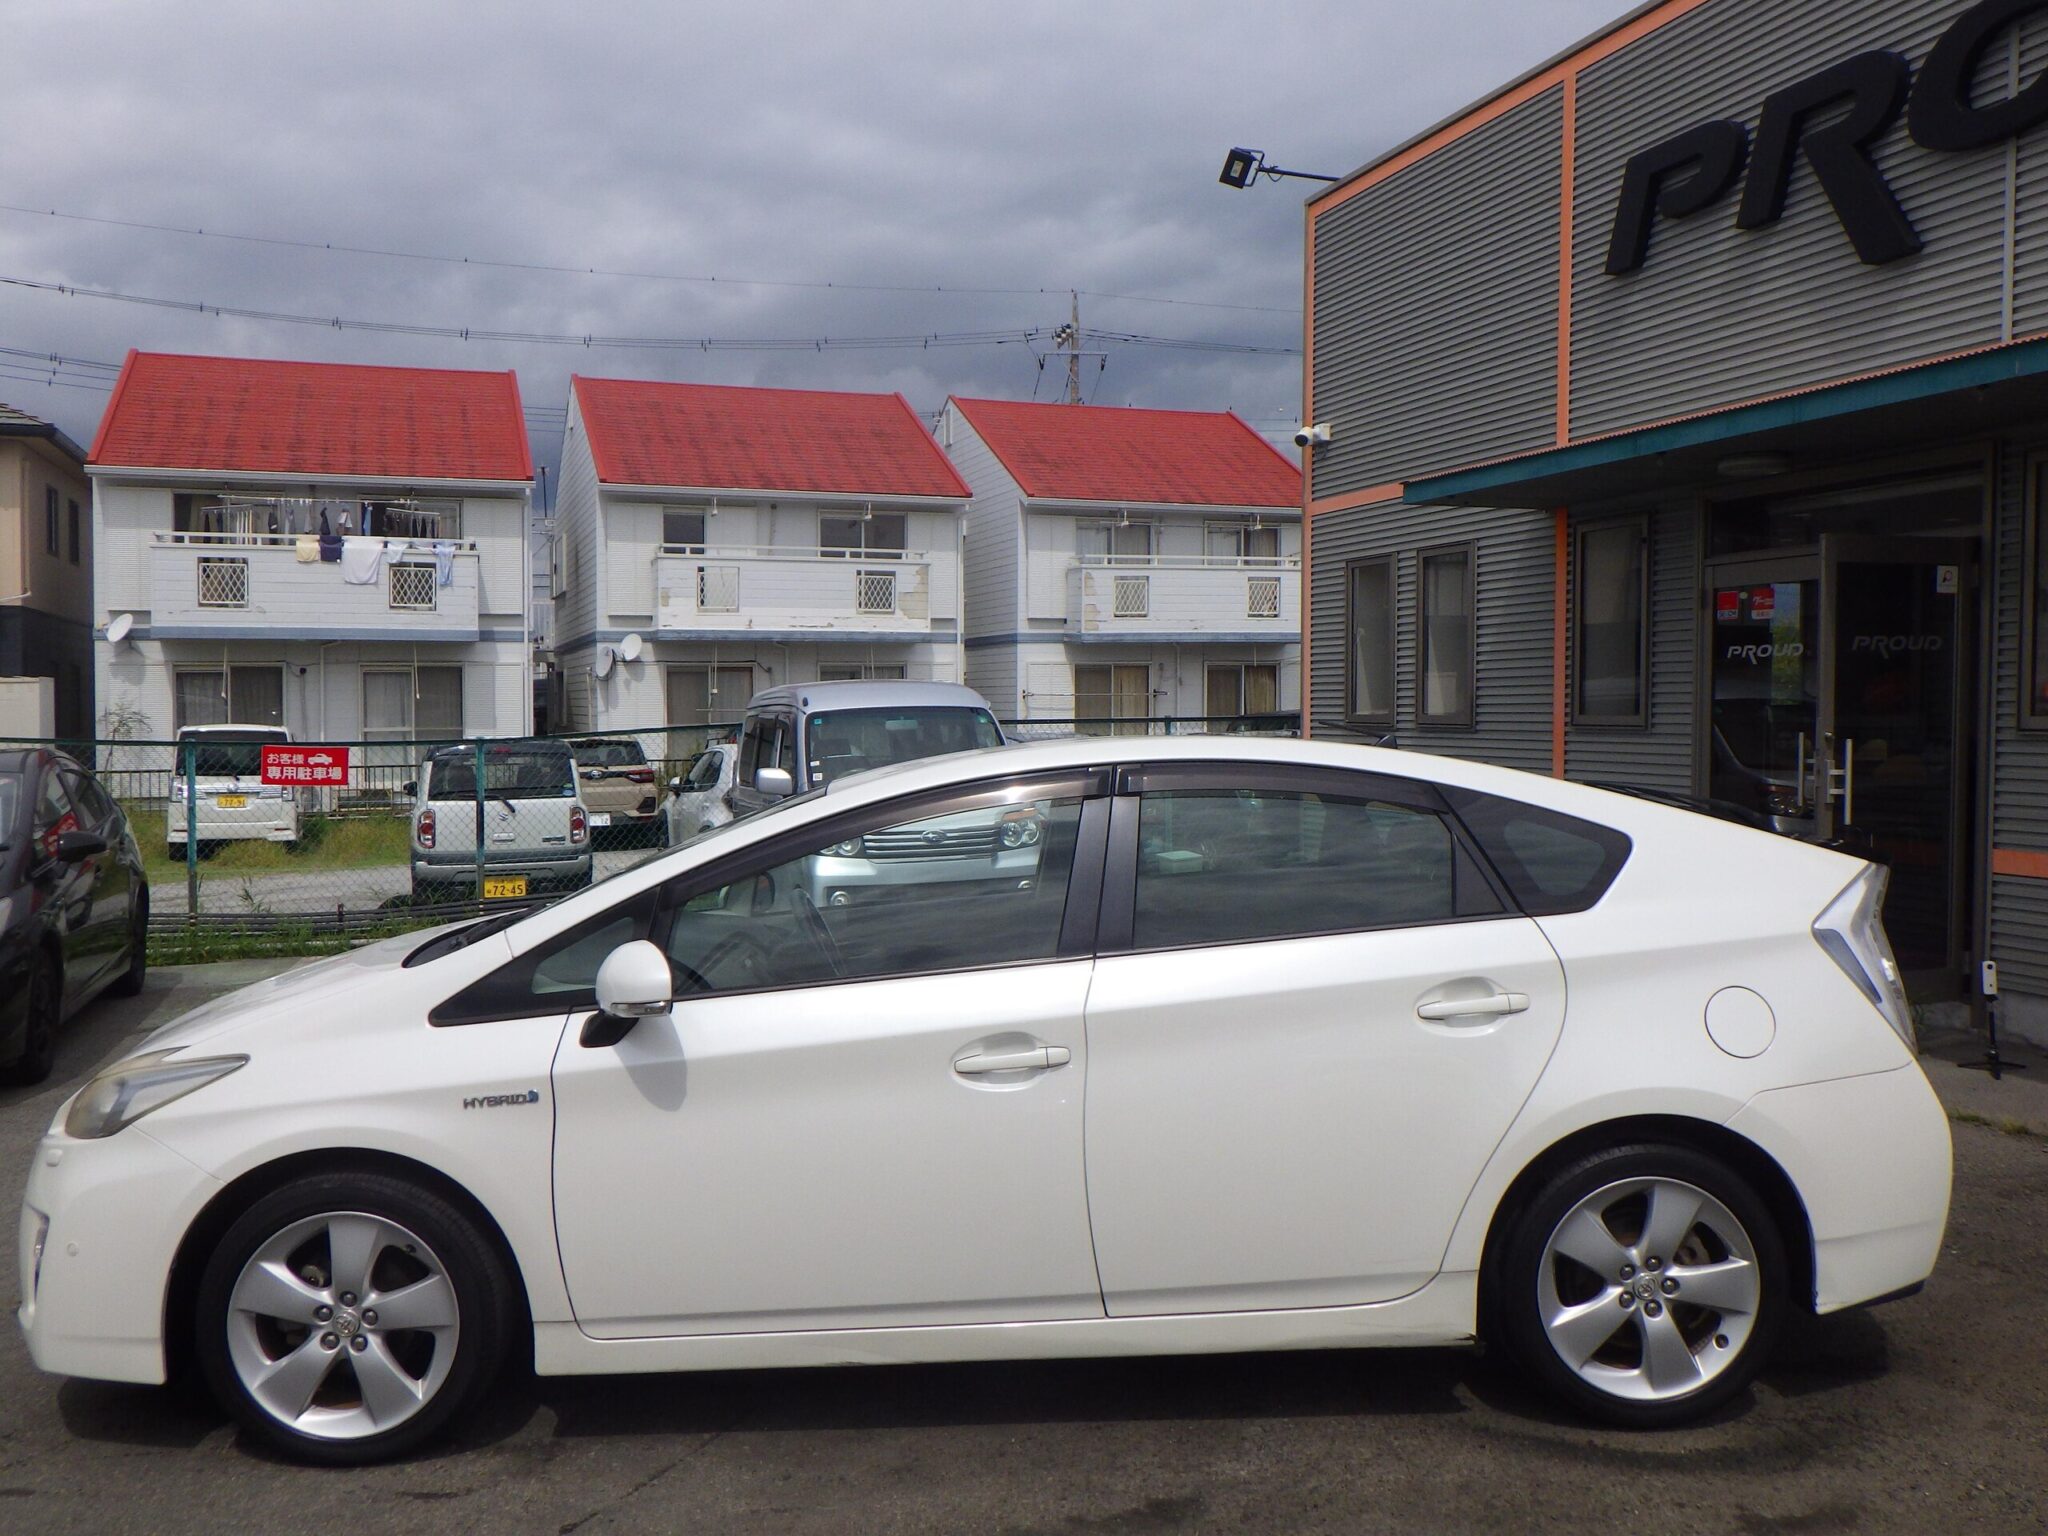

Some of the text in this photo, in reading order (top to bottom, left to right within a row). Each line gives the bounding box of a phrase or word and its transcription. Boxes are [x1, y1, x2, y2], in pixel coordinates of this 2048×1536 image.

[1727, 643, 1804, 665] PROUD
[1852, 635, 1942, 659] PROUD
[266, 752, 305, 766] お客様
[266, 766, 342, 781] 専用駐車場
[463, 1092, 527, 1110] HYBRID
